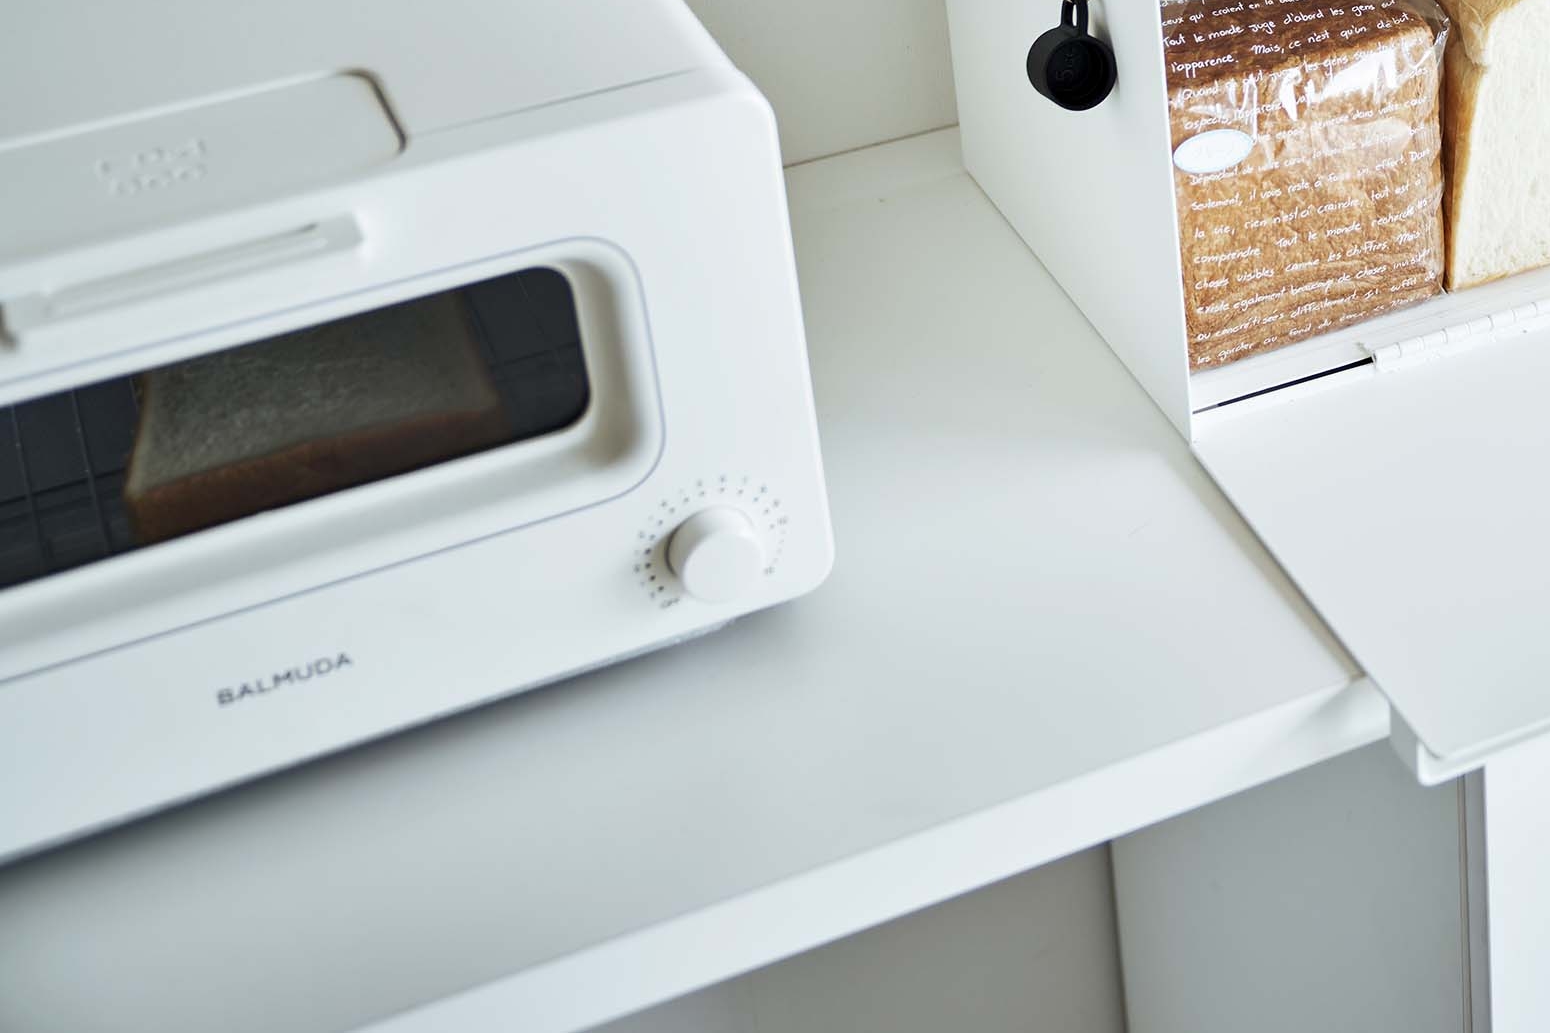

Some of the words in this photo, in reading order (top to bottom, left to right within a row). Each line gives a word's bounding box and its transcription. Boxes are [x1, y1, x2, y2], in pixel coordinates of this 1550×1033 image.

[1189, 11, 1205, 24] qui
[1212, 1, 1246, 17] croient
[1248, 2, 1261, 10] en
[1193, 32, 1206, 44] le
[1208, 24, 1245, 41] monde
[1283, 10, 1326, 26] d'abord
[1329, 7, 1345, 18] les
[1351, 3, 1376, 17] gens
[1171, 53, 1240, 80] l'apparence.
[1288, 40, 1303, 50] ce
[1307, 29, 1331, 45] n'est
[1340, 25, 1368, 41] qu'un
[1260, 188, 1282, 199] vous
[1194, 246, 1261, 266] comprendre
[1308, 231, 1318, 241] le
[1326, 221, 1361, 236] monde
[1195, 227, 1205, 239] la
[1237, 267, 1275, 282] visibles
[1327, 252, 1342, 263] les
[1337, 272, 1351, 284] de
[216, 652, 353, 706] BALMUDA
